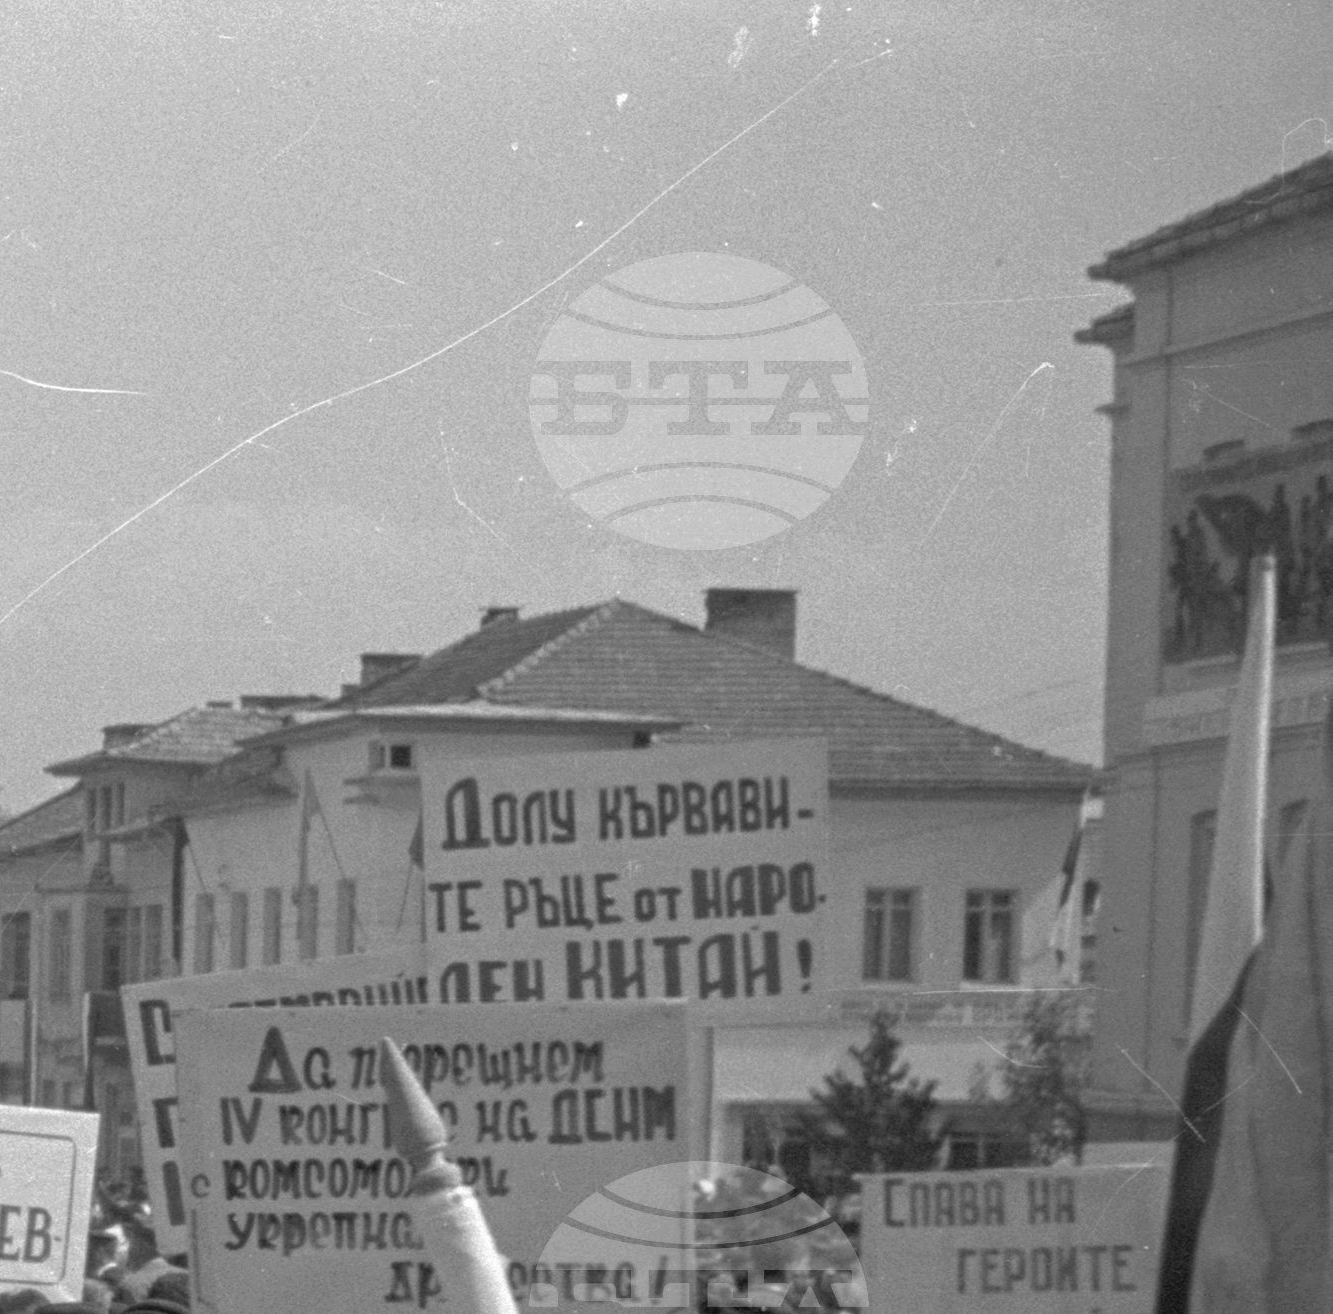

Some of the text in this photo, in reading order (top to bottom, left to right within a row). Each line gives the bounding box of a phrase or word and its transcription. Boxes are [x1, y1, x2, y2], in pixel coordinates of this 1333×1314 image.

[598, 776, 815, 841] КЪРВАВИ-
[428, 881, 483, 932] ТЕ
[503, 873, 623, 931] РЪЦЕ
[690, 861, 827, 920] НАРО-
[220, 1097, 263, 1145] IV
[476, 1099, 538, 1142] на
[548, 1086, 675, 1145] ДСНМ
[885, 1175, 1076, 1229] СЛАВА НА
[957, 1244, 1137, 1294] ГЕРОИТЕ
